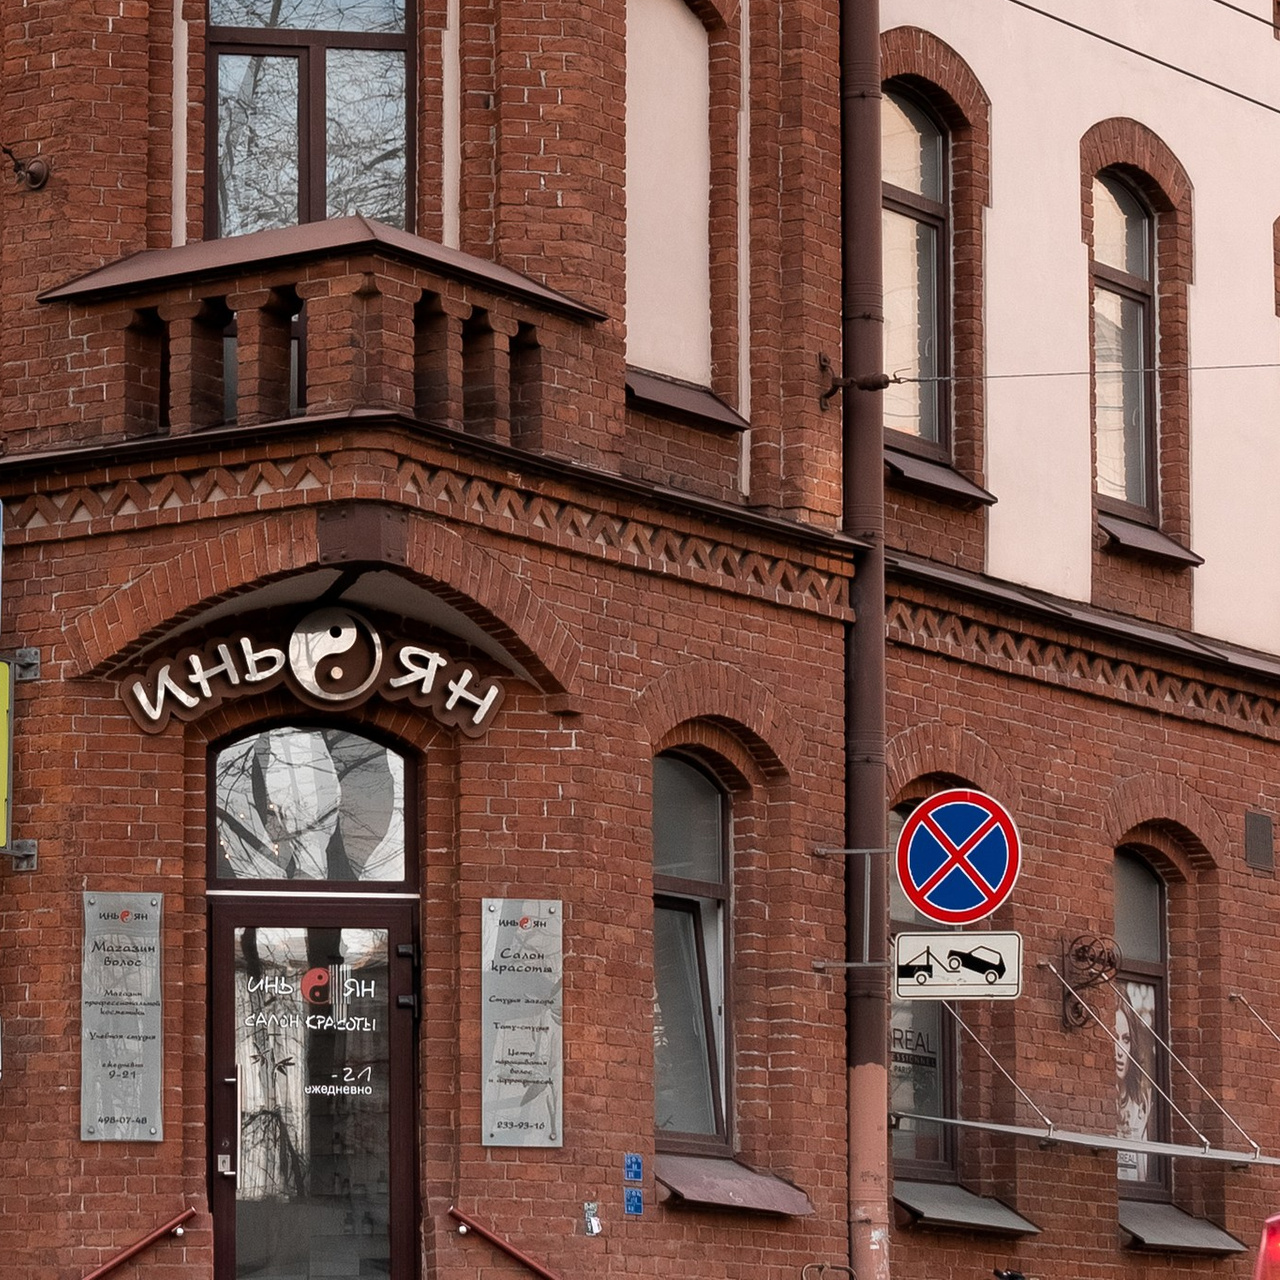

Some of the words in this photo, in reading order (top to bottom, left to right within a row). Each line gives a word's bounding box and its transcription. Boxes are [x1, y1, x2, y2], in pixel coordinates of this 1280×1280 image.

[132, 637, 286, 721] ИНЬ
[389, 645, 499, 725] ЯН
[99, 912, 119, 920] ИНЬ
[134, 912, 148, 920] ЯН
[498, 919, 518, 927] ИНЬ
[532, 920, 547, 928] ЯН
[91, 941, 155, 953] Магазин
[500, 948, 545, 959] Салон
[247, 976, 294, 994] ИНЬ
[343, 978, 376, 998] ЯН
[104, 989, 142, 997] Магазин
[488, 995, 521, 1005] Студия
[100, 1007, 145, 1016] косметики
[244, 1012, 299, 1028] САЛОН
[305, 1015, 376, 1031] КРАСОТЫ
[493, 1022, 550, 1032] Тату-студия
[891, 1027, 937, 1054] RÉAL
[507, 1048, 536, 1057] Центр
[102, 1060, 144, 1069] ежедневно
[109, 1070, 136, 1079] 9-21
[304, 1084, 373, 1096] ежедневно
[98, 1116, 148, 1124] 498-07-48
[497, 1121, 546, 1130] 233-93-16
